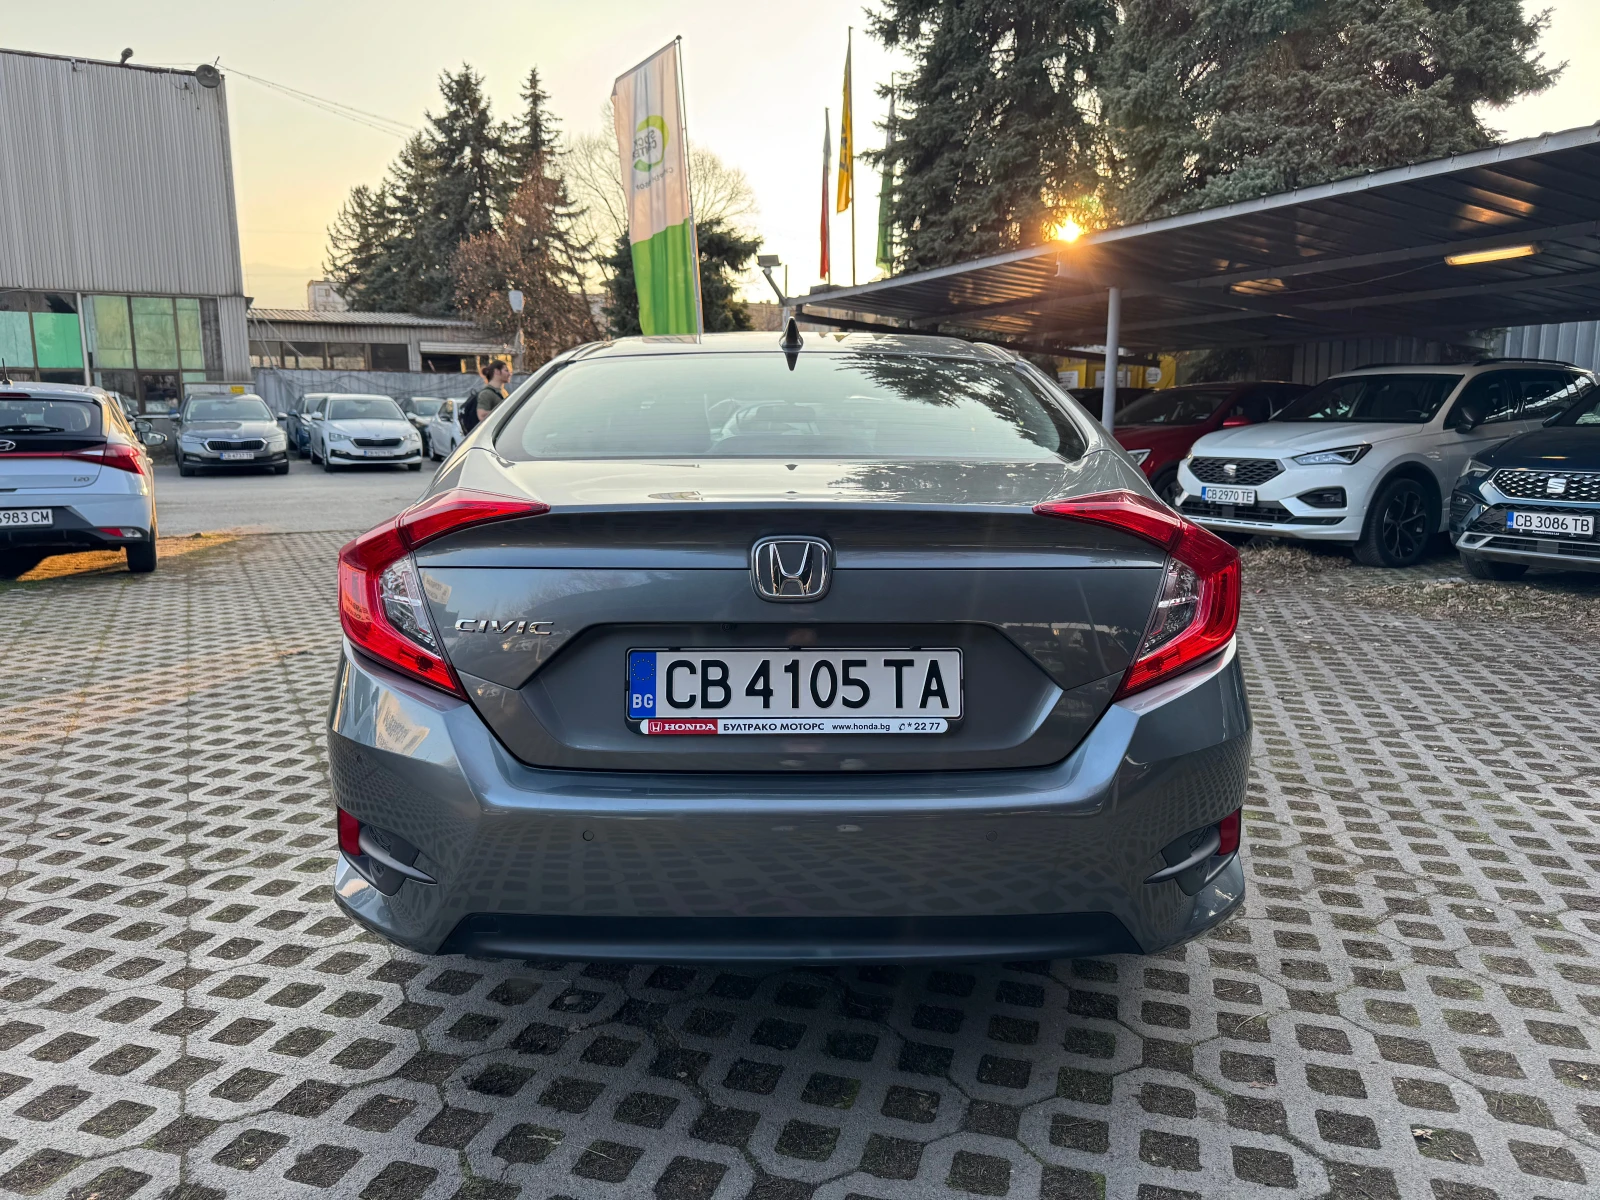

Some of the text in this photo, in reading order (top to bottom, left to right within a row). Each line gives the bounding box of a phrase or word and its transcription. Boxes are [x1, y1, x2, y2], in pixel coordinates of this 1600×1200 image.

[1206, 488, 1253, 502] CB 2970 TE
[31, 510, 50, 523] CM
[1515, 514, 1590, 532] CB 3086 TB
[454, 619, 555, 635] CIVIC
[665, 659, 949, 709] CB 4105 TA
[632, 693, 654, 709] BG
[664, 723, 717, 731] HONDA
[723, 722, 825, 732] БУЛТРАКО МОТОРС
[832, 722, 891, 732] www.honda.bg
